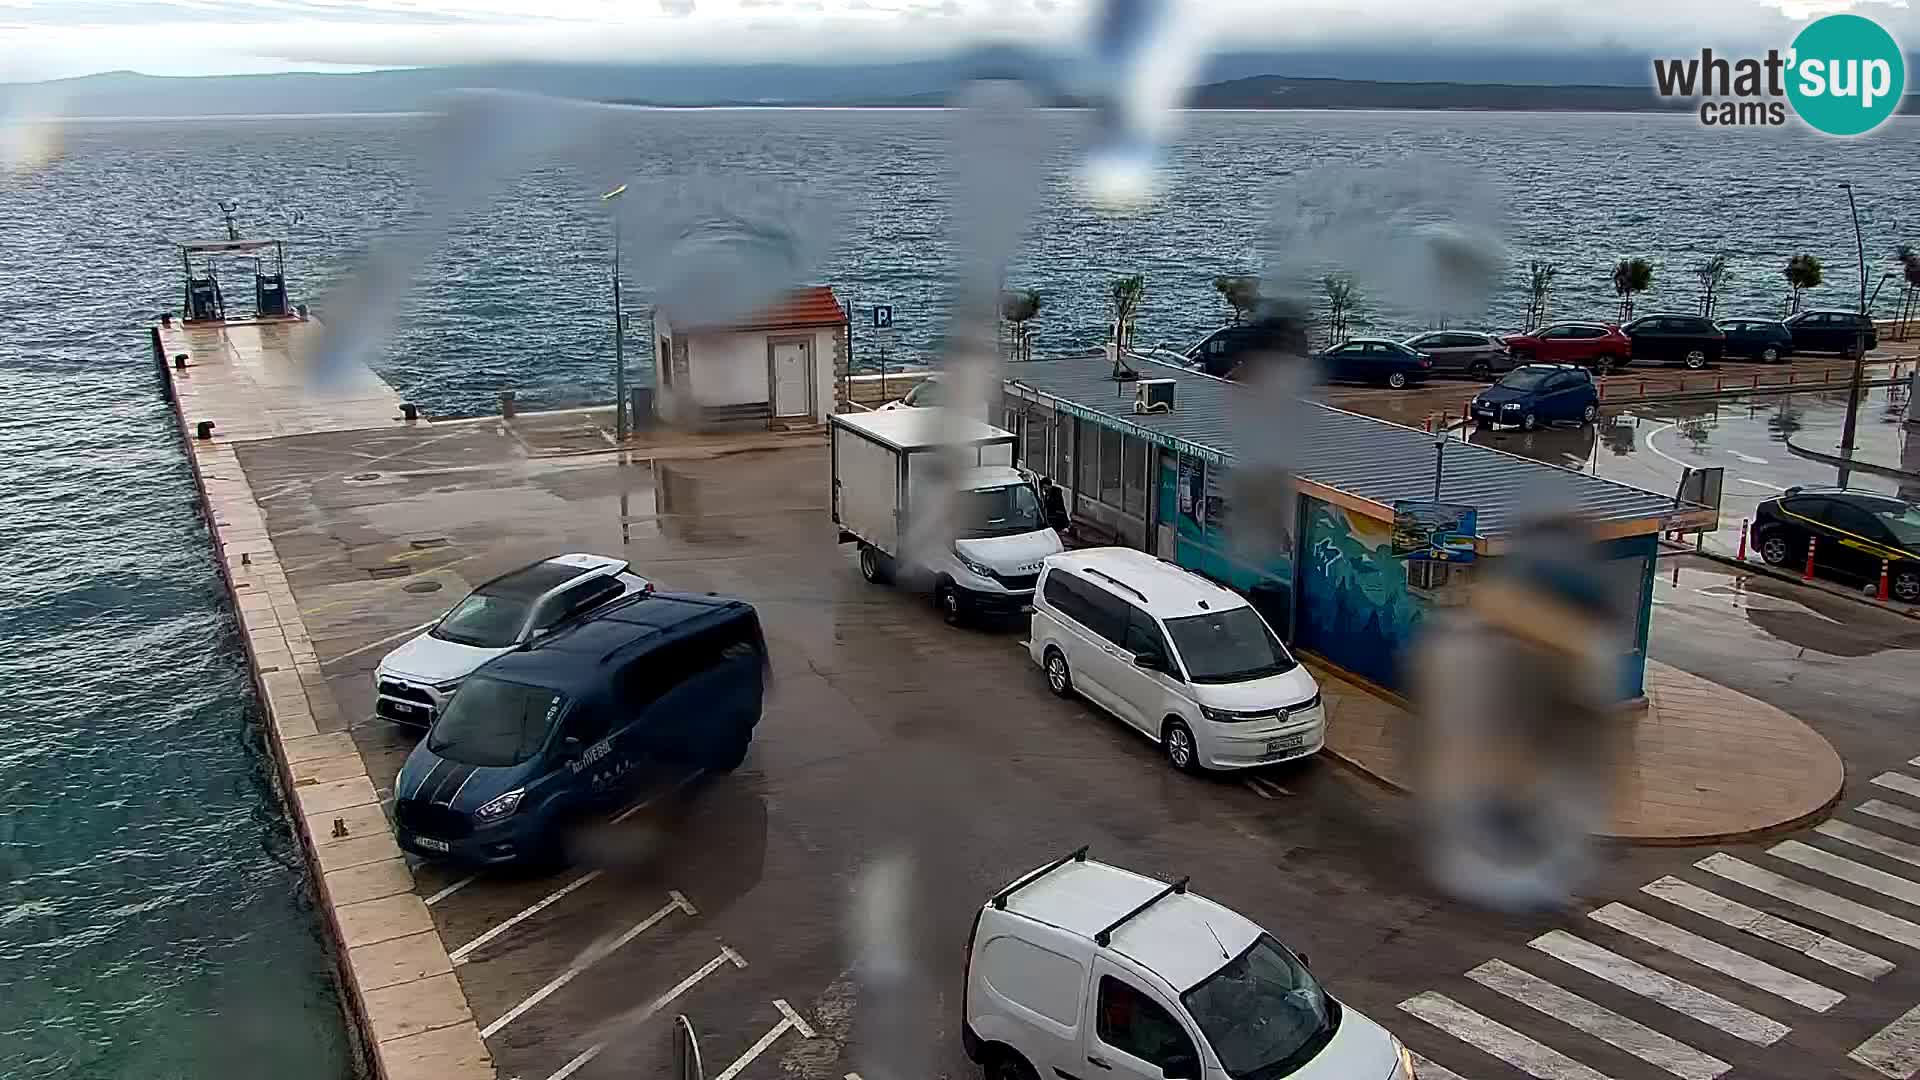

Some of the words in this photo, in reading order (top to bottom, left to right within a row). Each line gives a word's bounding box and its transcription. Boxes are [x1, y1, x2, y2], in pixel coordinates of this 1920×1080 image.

[878, 308, 888, 325] P
[1174, 440, 1189, 454] BUS
[1189, 444, 1219, 465] STATION
